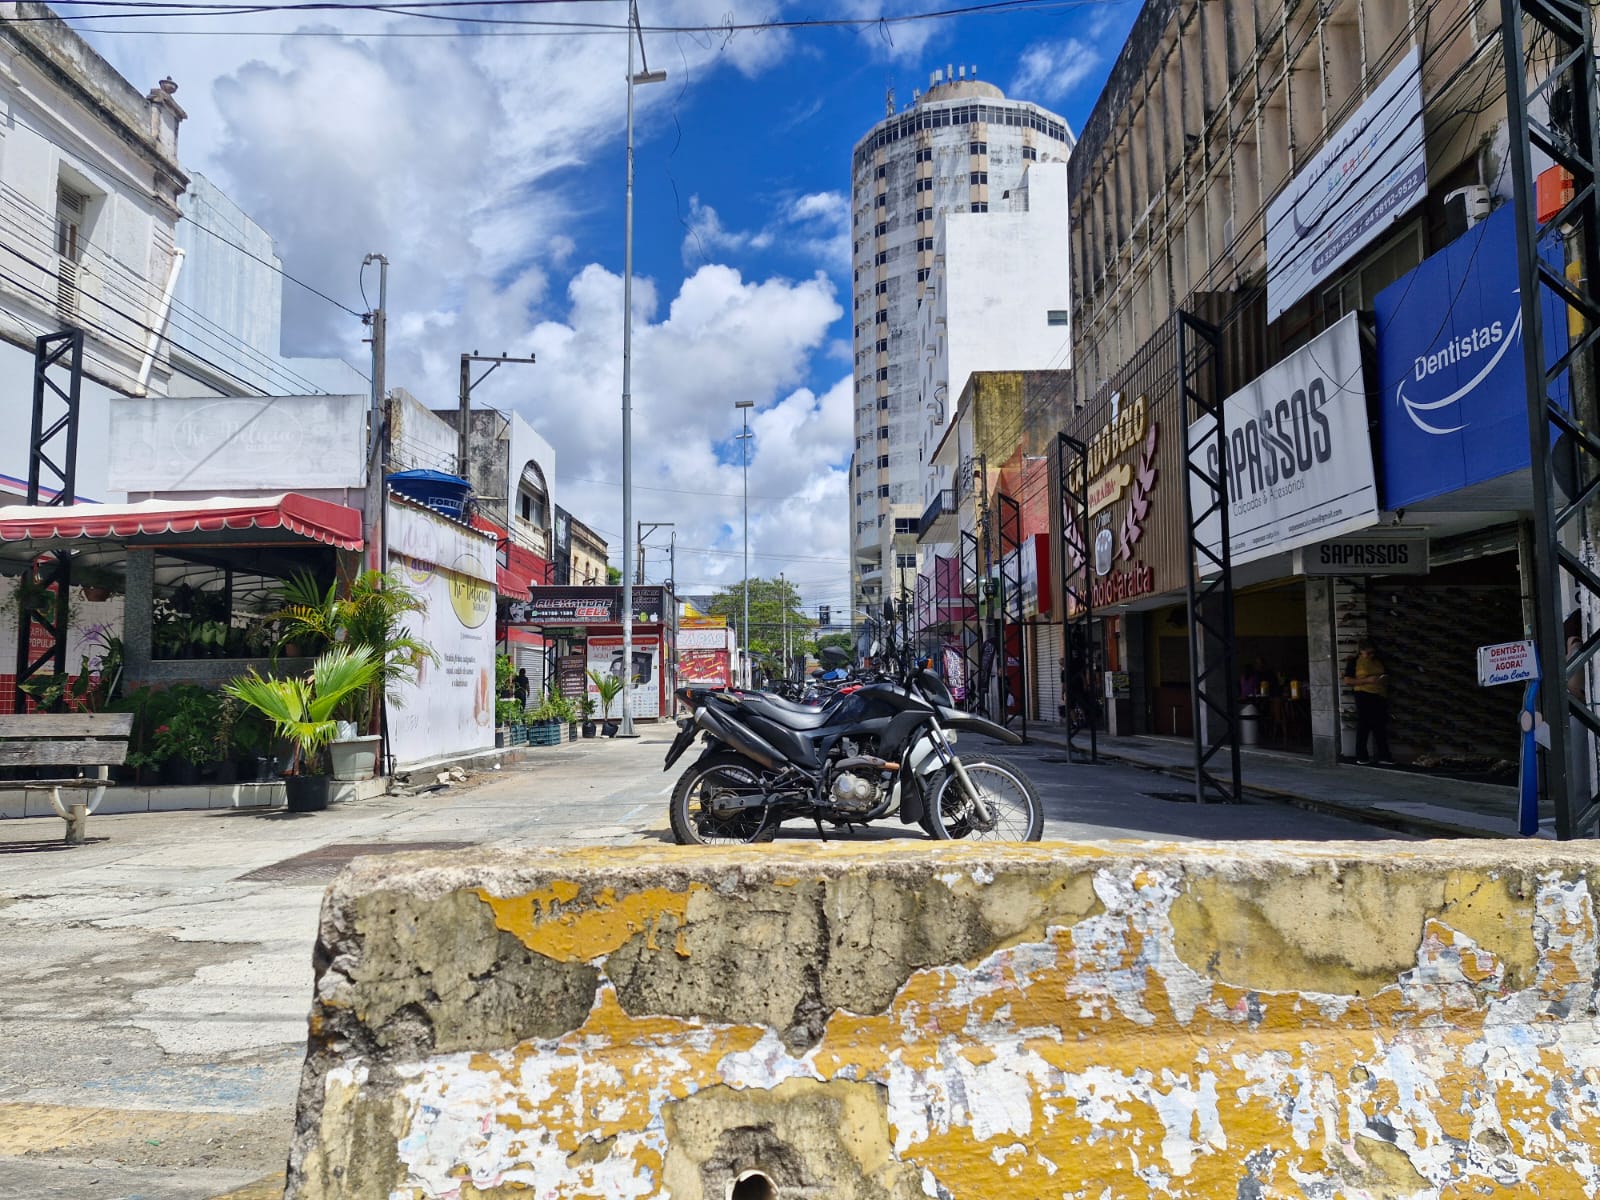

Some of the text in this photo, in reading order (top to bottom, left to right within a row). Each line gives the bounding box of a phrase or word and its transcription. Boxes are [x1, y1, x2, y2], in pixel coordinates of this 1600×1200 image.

[1375, 174, 1418, 215] 98112-9522
[1415, 320, 1503, 383] Dentistas
[1206, 377, 1332, 512] SAPASSOS
[1233, 494, 1261, 517] Calçados
[1269, 478, 1305, 501] Acessórios
[1320, 544, 1409, 565] SAPASSOS
[535, 598, 613, 608] ALEXANDRE
[576, 607, 609, 617] CELL
[1491, 645, 1525, 657] DENTISTA
[1495, 660, 1523, 672] AGORA!
[1511, 669, 1530, 680] Centro
